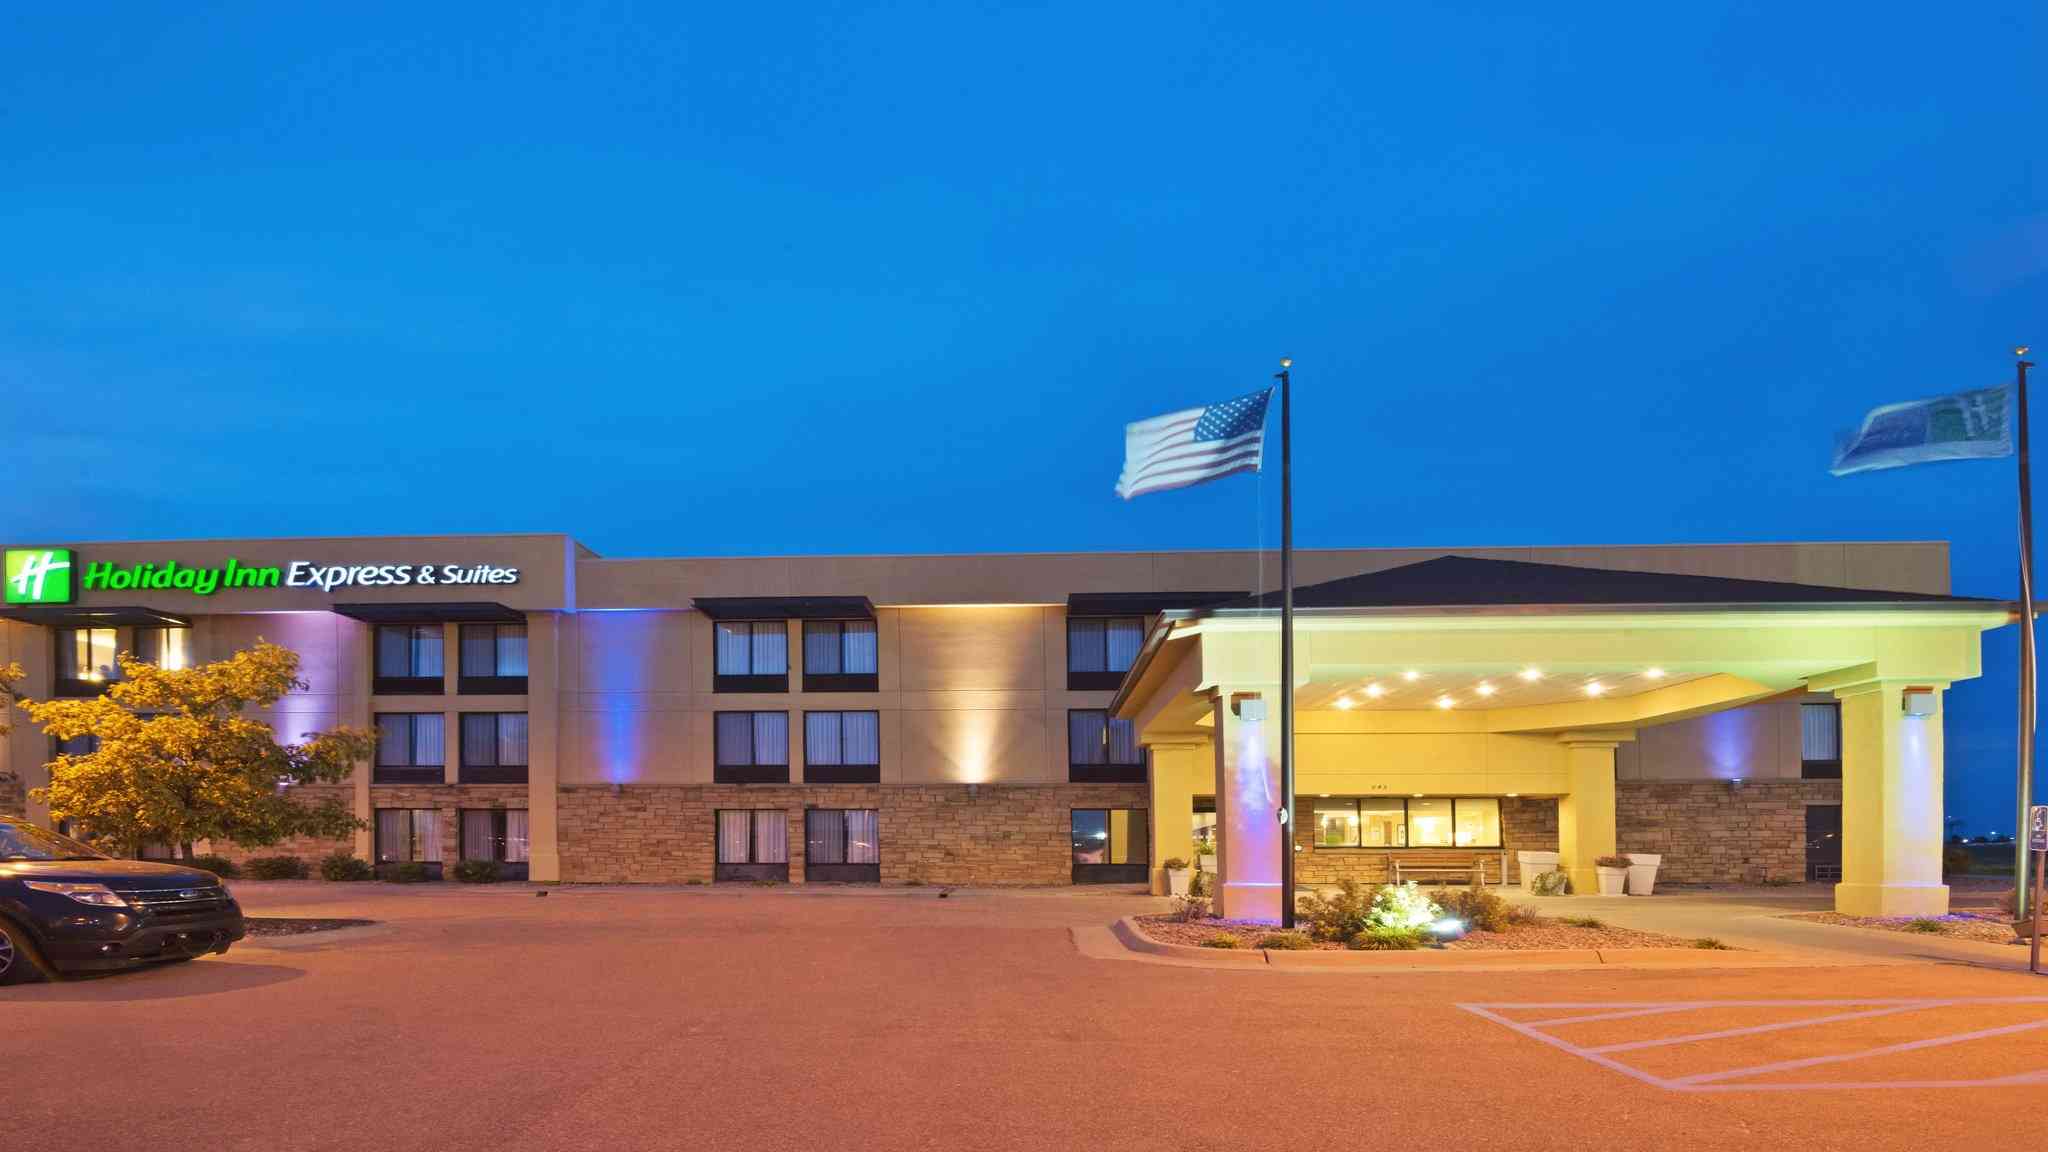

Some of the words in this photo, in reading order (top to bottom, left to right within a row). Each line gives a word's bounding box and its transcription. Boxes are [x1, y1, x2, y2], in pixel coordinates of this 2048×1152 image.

[83, 560, 219, 595] Holiday
[223, 558, 280, 587] Inn
[286, 560, 412, 592] Express
[416, 564, 436, 585] &
[439, 564, 518, 584] Suites
